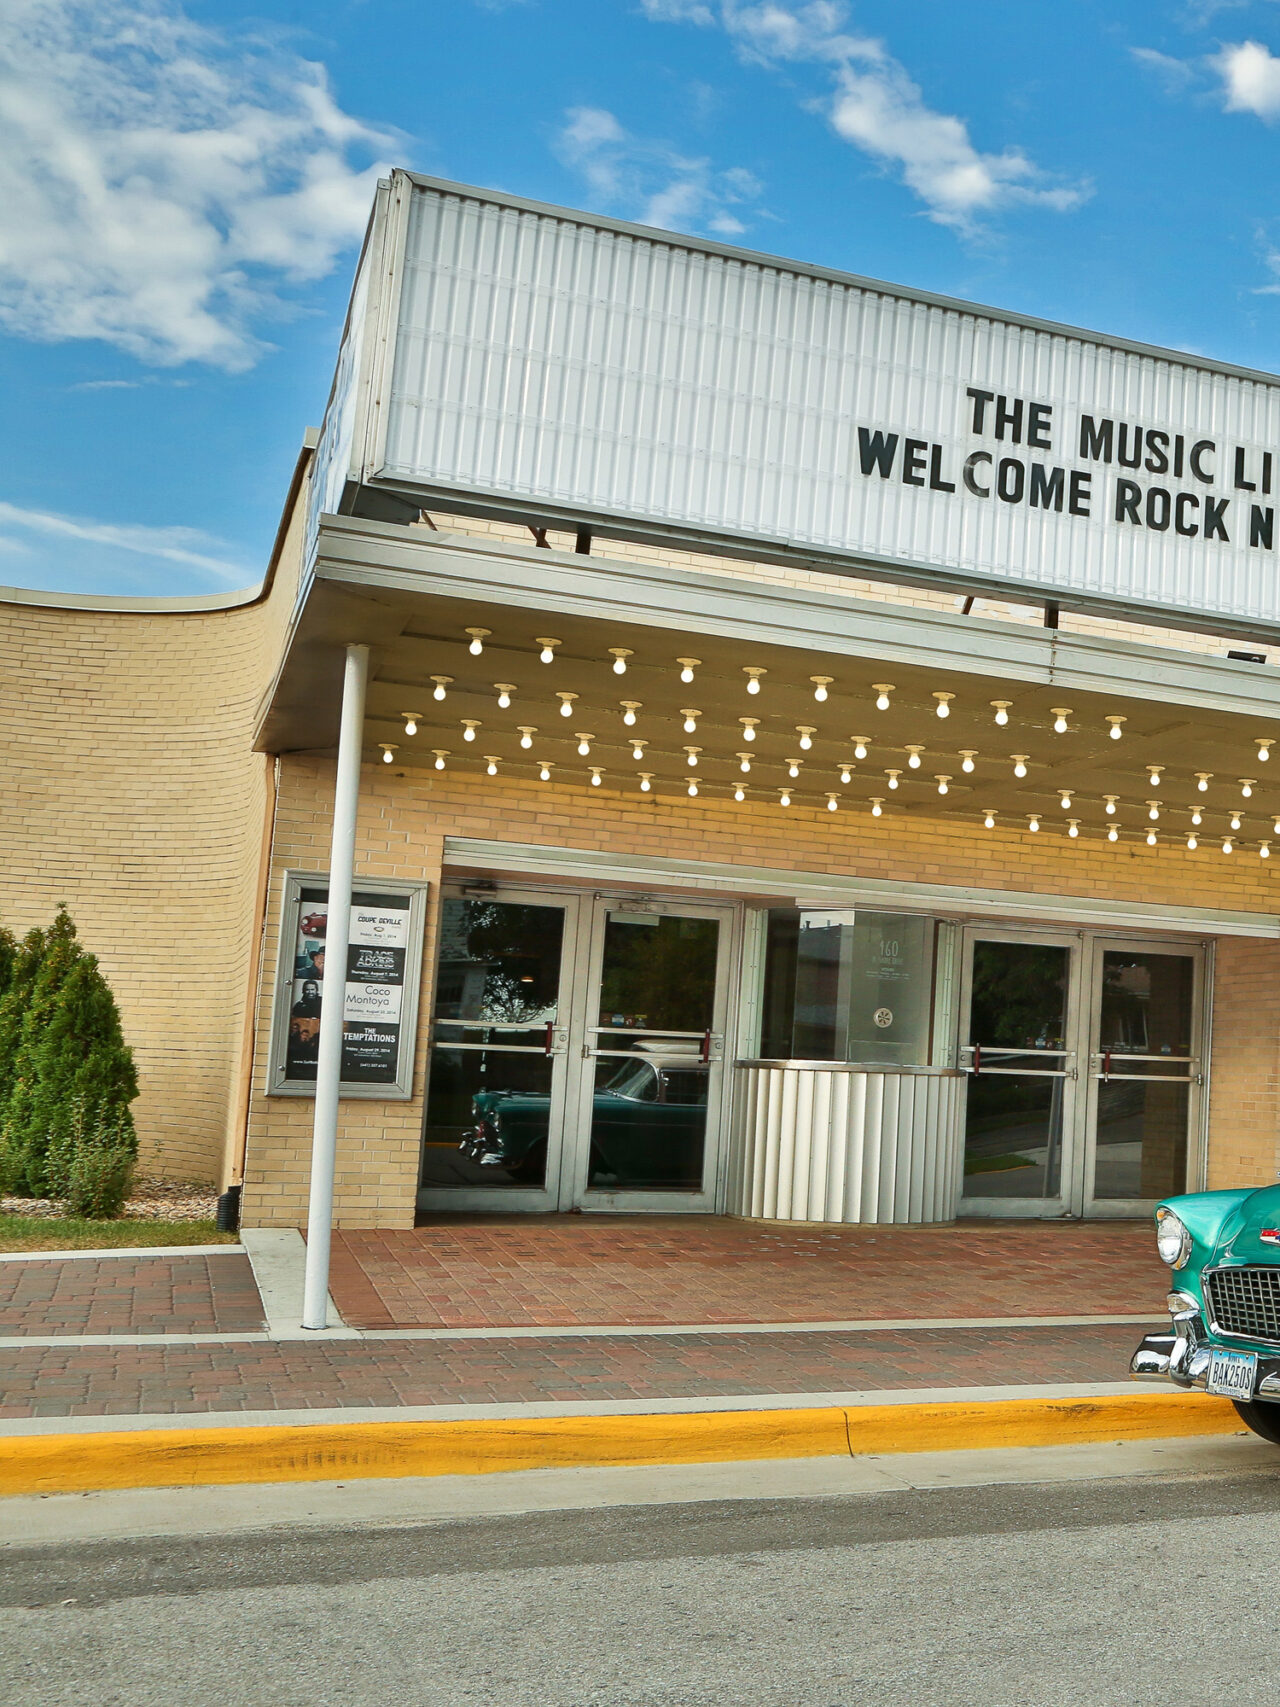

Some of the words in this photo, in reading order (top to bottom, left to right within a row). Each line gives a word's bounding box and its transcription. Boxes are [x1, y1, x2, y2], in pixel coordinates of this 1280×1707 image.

[966, 387, 1053, 450] THE
[1079, 414, 1216, 484] MUSIC
[858, 427, 1092, 517] WELCOME
[1115, 478, 1230, 542] ROCK
[1250, 504, 1274, 550] N
[365, 985, 391, 995] Coco
[346, 995, 389, 1007] Montoya
[343, 1032, 396, 1043] TEMPTATIONS
